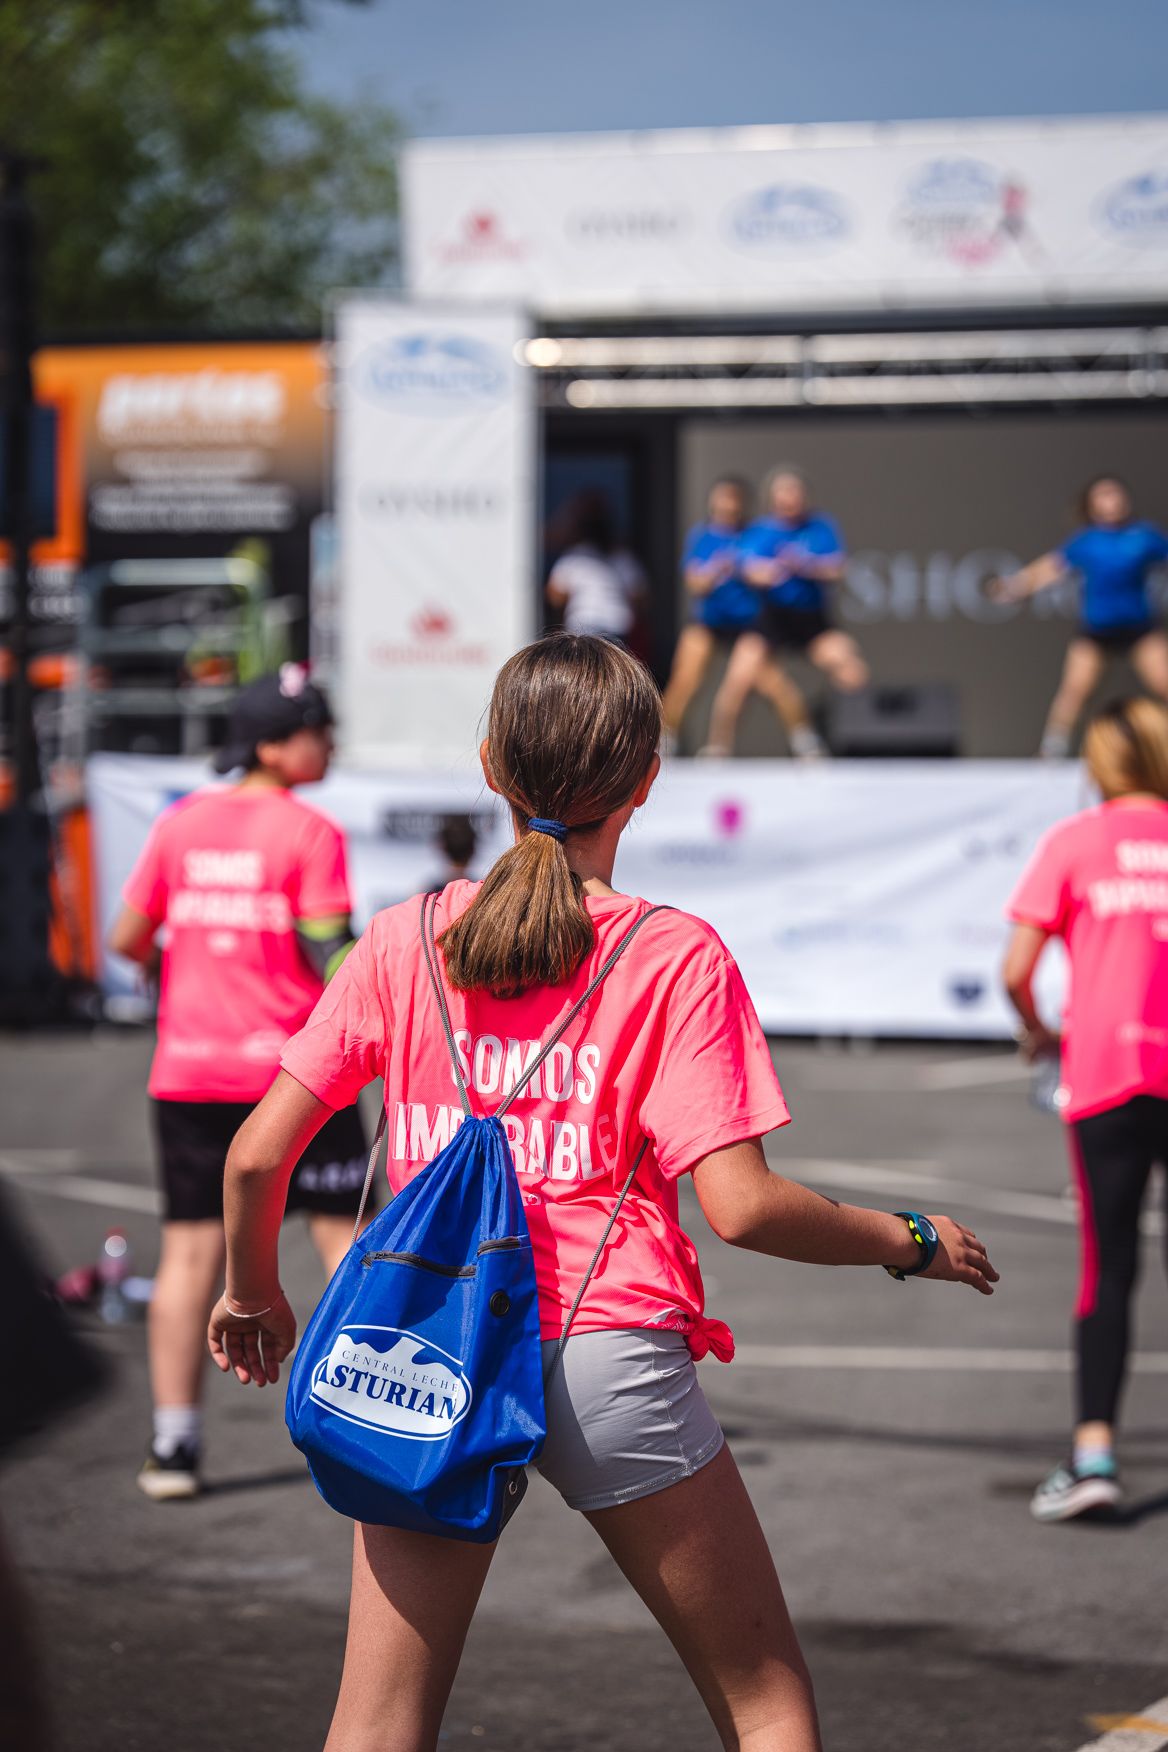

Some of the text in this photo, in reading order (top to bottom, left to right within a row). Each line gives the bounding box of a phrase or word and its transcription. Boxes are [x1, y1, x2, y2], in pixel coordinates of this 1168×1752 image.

[452, 1029, 601, 1105] SOMOS
[393, 1101, 617, 1181] IMRABLE
[342, 1349, 459, 1393] CENTRAL LECHE
